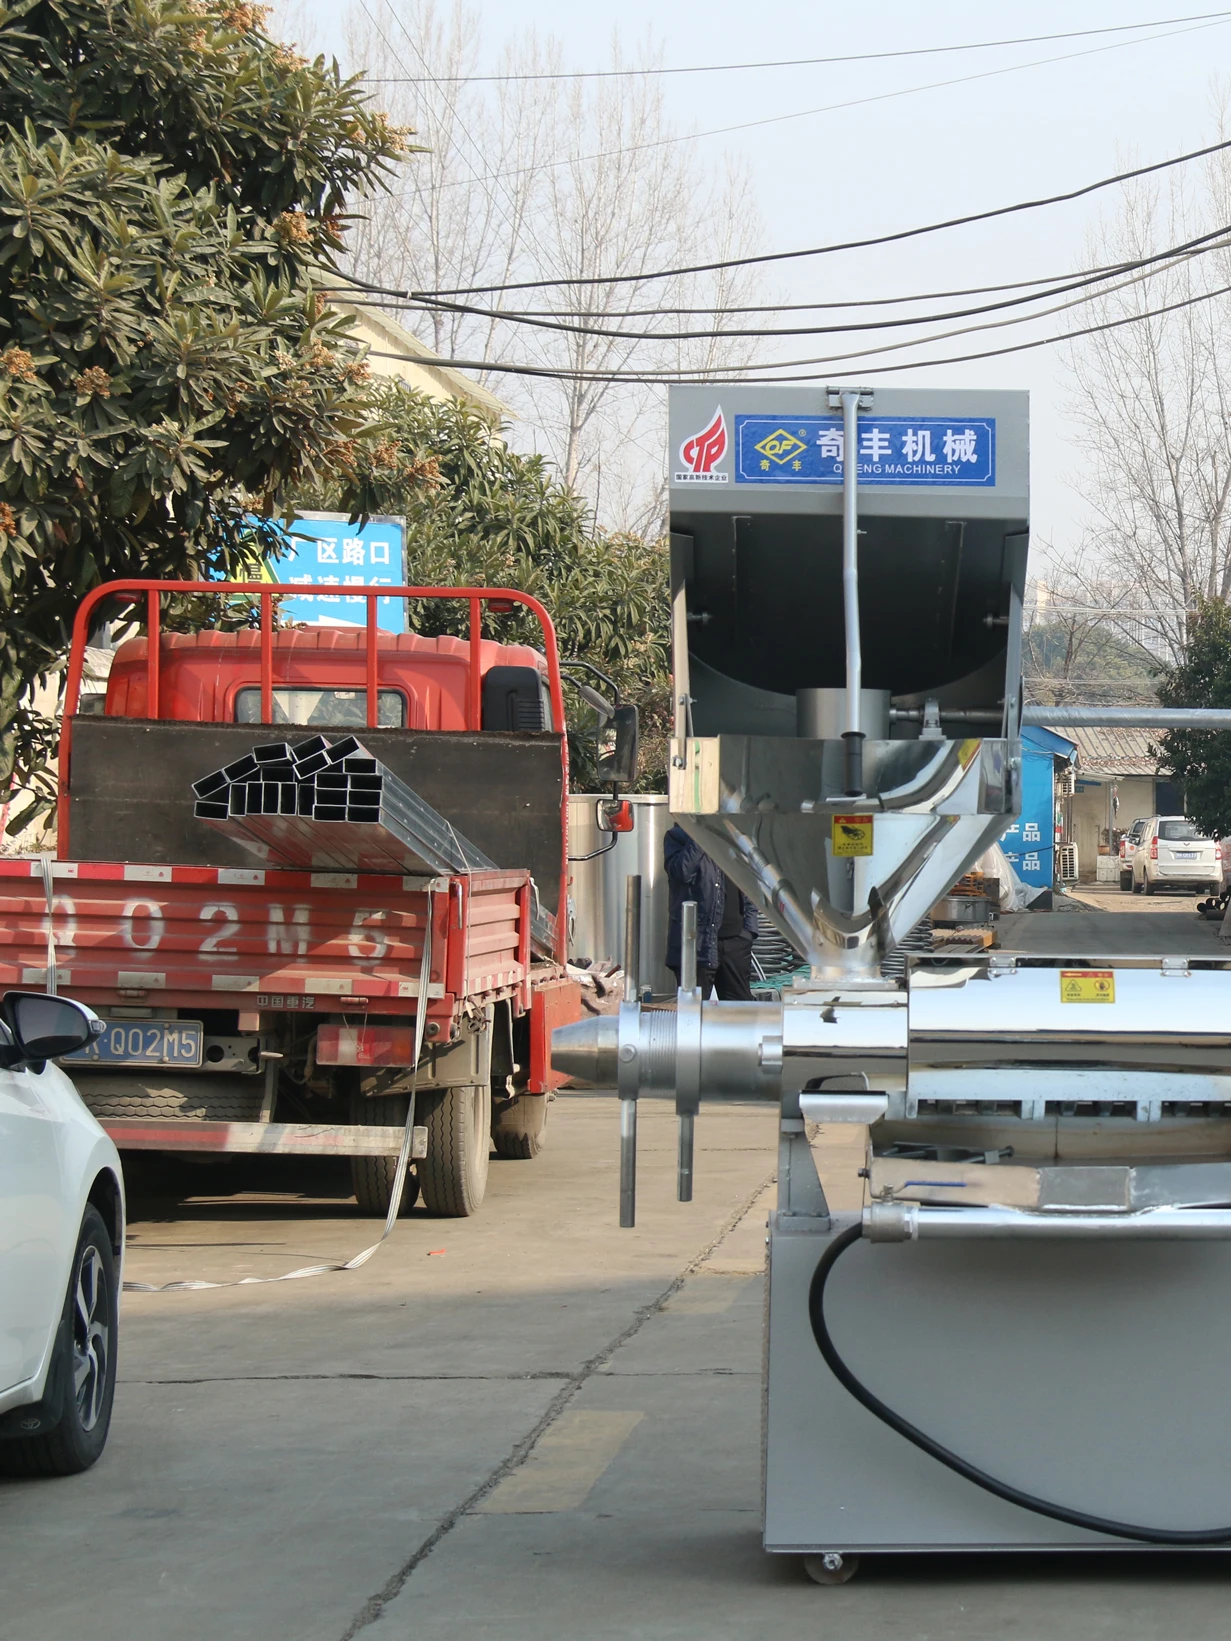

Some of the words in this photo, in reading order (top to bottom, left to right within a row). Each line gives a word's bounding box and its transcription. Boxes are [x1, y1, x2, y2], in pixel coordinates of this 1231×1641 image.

[816, 427, 978, 463] 奇丰机械
[833, 463, 882, 474] QENG
[885, 464, 961, 475] MACHINERY
[288, 537, 390, 565] 厂区路口
[256, 995, 315, 1009] 中国重汽
